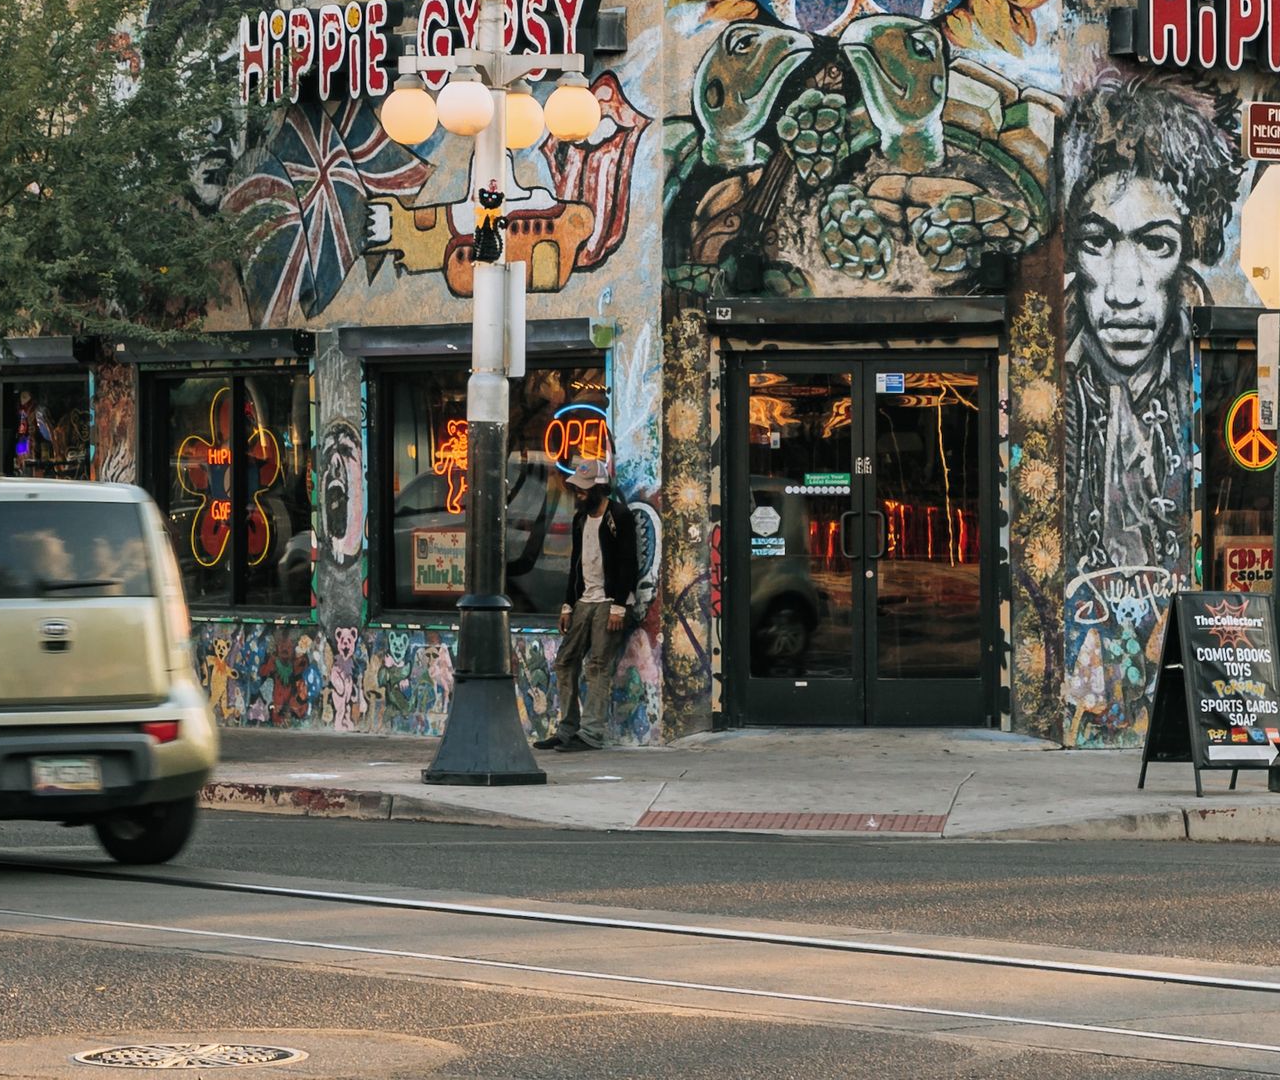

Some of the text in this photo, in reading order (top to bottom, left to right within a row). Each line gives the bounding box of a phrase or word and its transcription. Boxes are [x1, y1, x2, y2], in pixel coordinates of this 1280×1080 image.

[1238, 570, 1273, 581] SOLD
[1197, 647, 1271, 663] COMIC BOOKS
[1224, 662, 1252, 677] TOYS
[1201, 699, 1278, 714] SPORTS CARDS
[1228, 713, 1257, 726] SOAP
